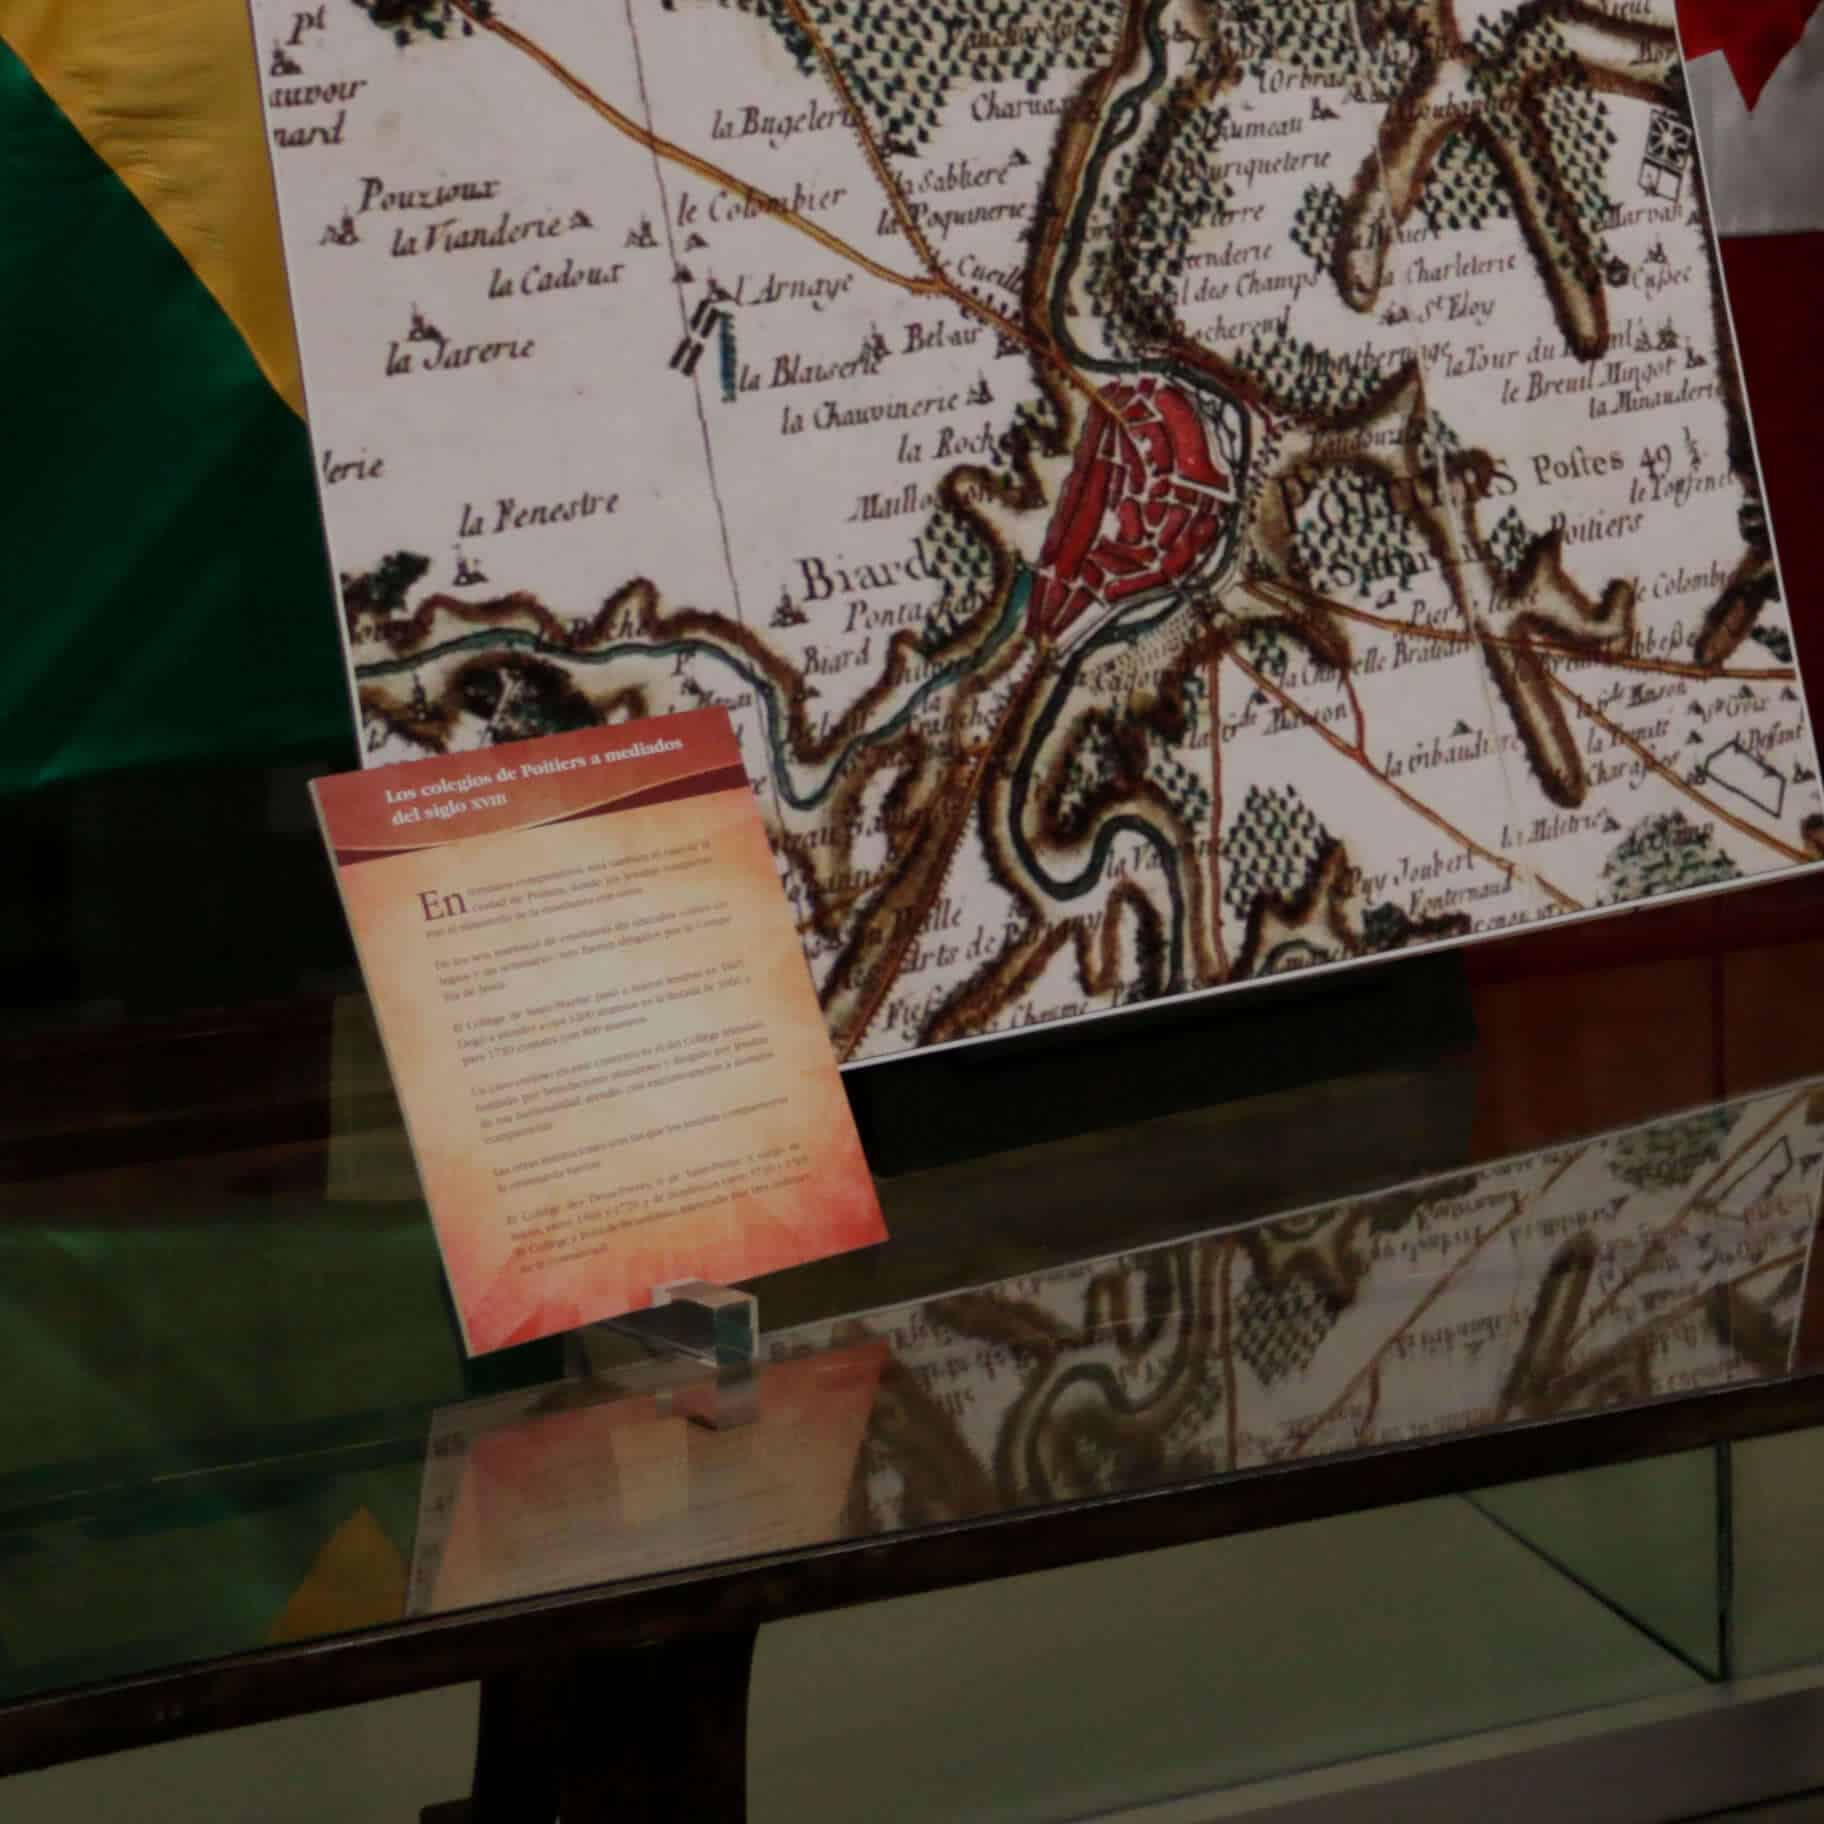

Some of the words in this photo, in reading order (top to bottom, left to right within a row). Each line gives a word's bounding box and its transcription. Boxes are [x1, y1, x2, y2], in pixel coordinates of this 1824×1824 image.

[385, 787, 417, 805] Los
[420, 773, 493, 797] colegios
[496, 765, 517, 782] de
[520, 754, 588, 778] Poitiers
[590, 753, 602, 767] a
[604, 737, 684, 762] mediados
[391, 808, 422, 826] del
[424, 799, 467, 821] siglo
[417, 888, 467, 922] En
